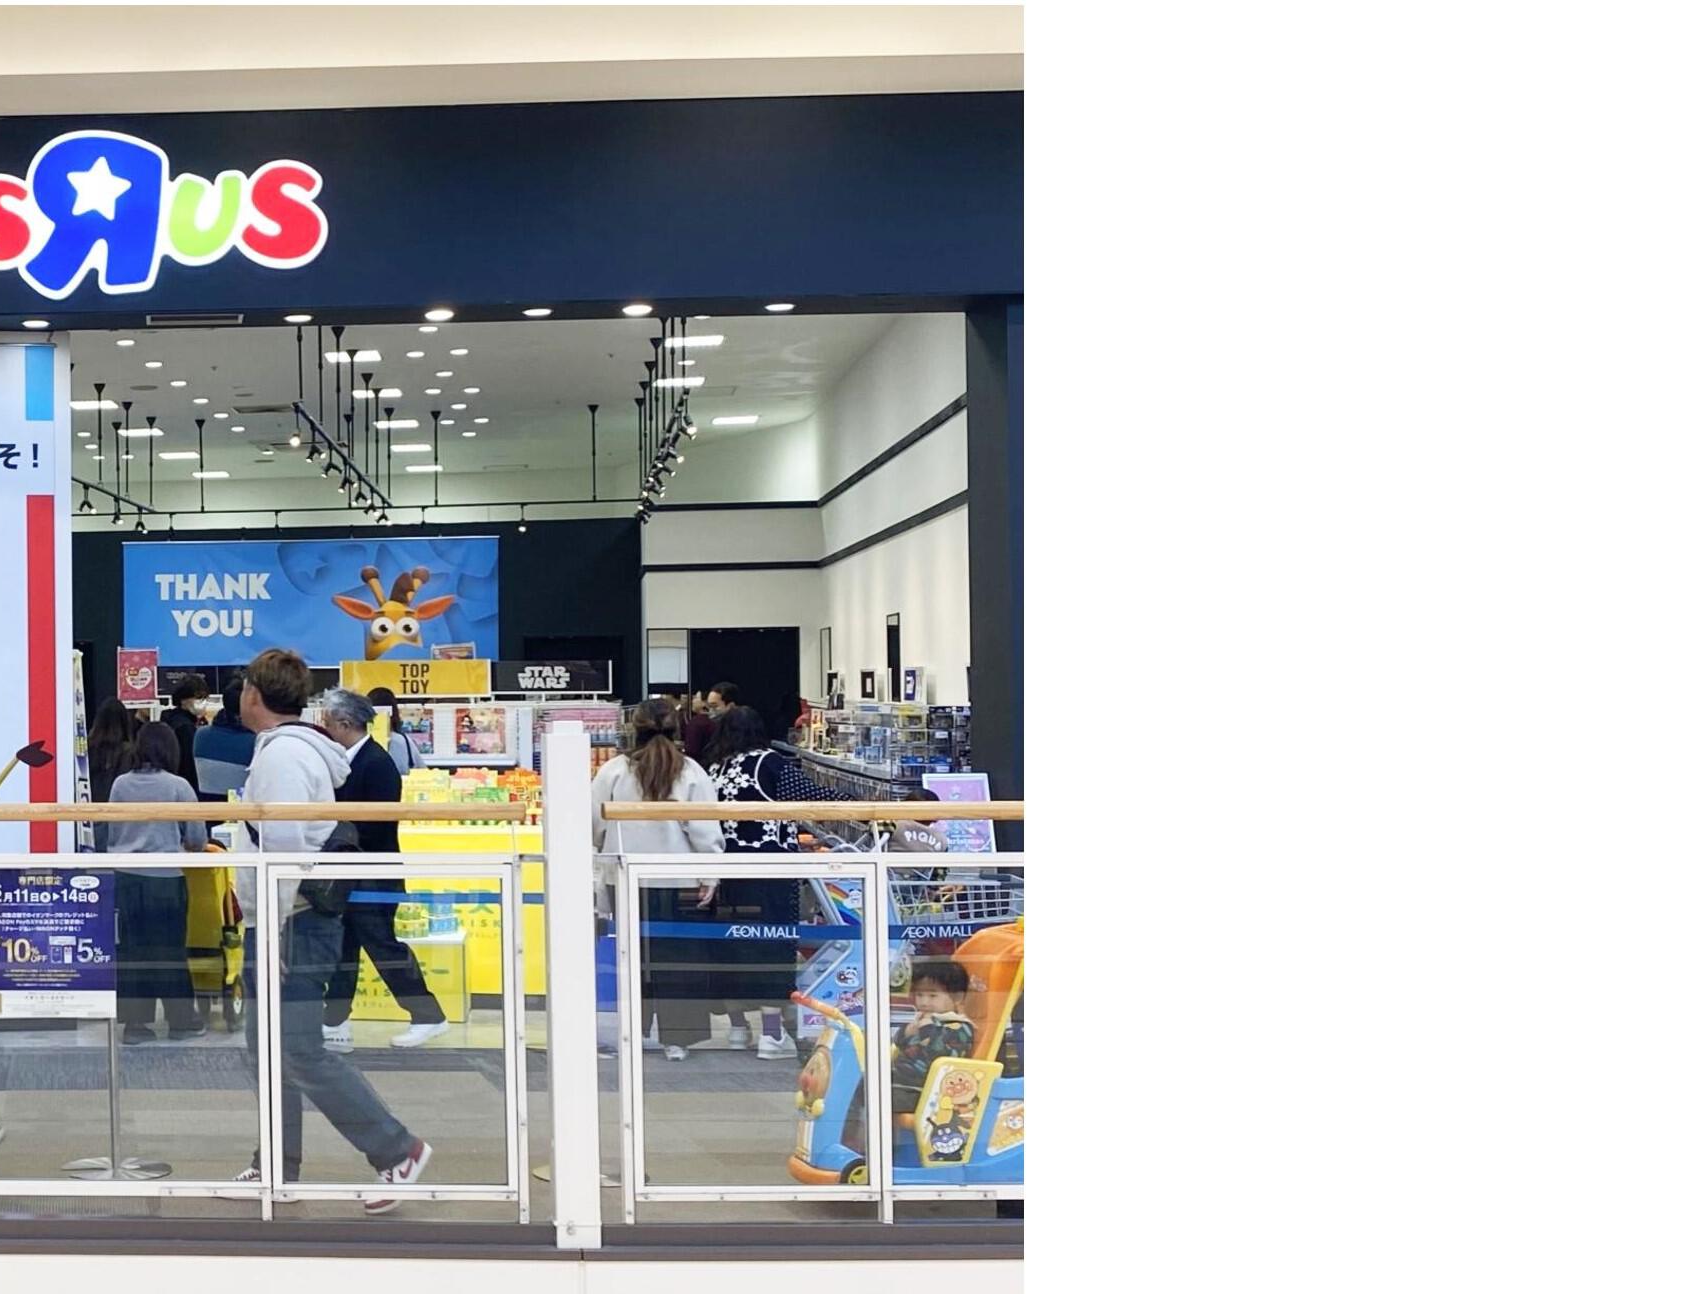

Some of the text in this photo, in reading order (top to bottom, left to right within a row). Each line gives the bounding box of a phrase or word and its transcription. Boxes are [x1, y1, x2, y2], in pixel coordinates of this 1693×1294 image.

[155, 573, 271, 600] THANK
[172, 609, 254, 637] YOU!
[400, 664, 430, 677] TOP
[518, 665, 570, 678] STAR
[399, 679, 429, 694] TOY
[518, 677, 570, 689] WARS
[763, 926, 800, 938] MALL
[939, 925, 973, 937] MALL
